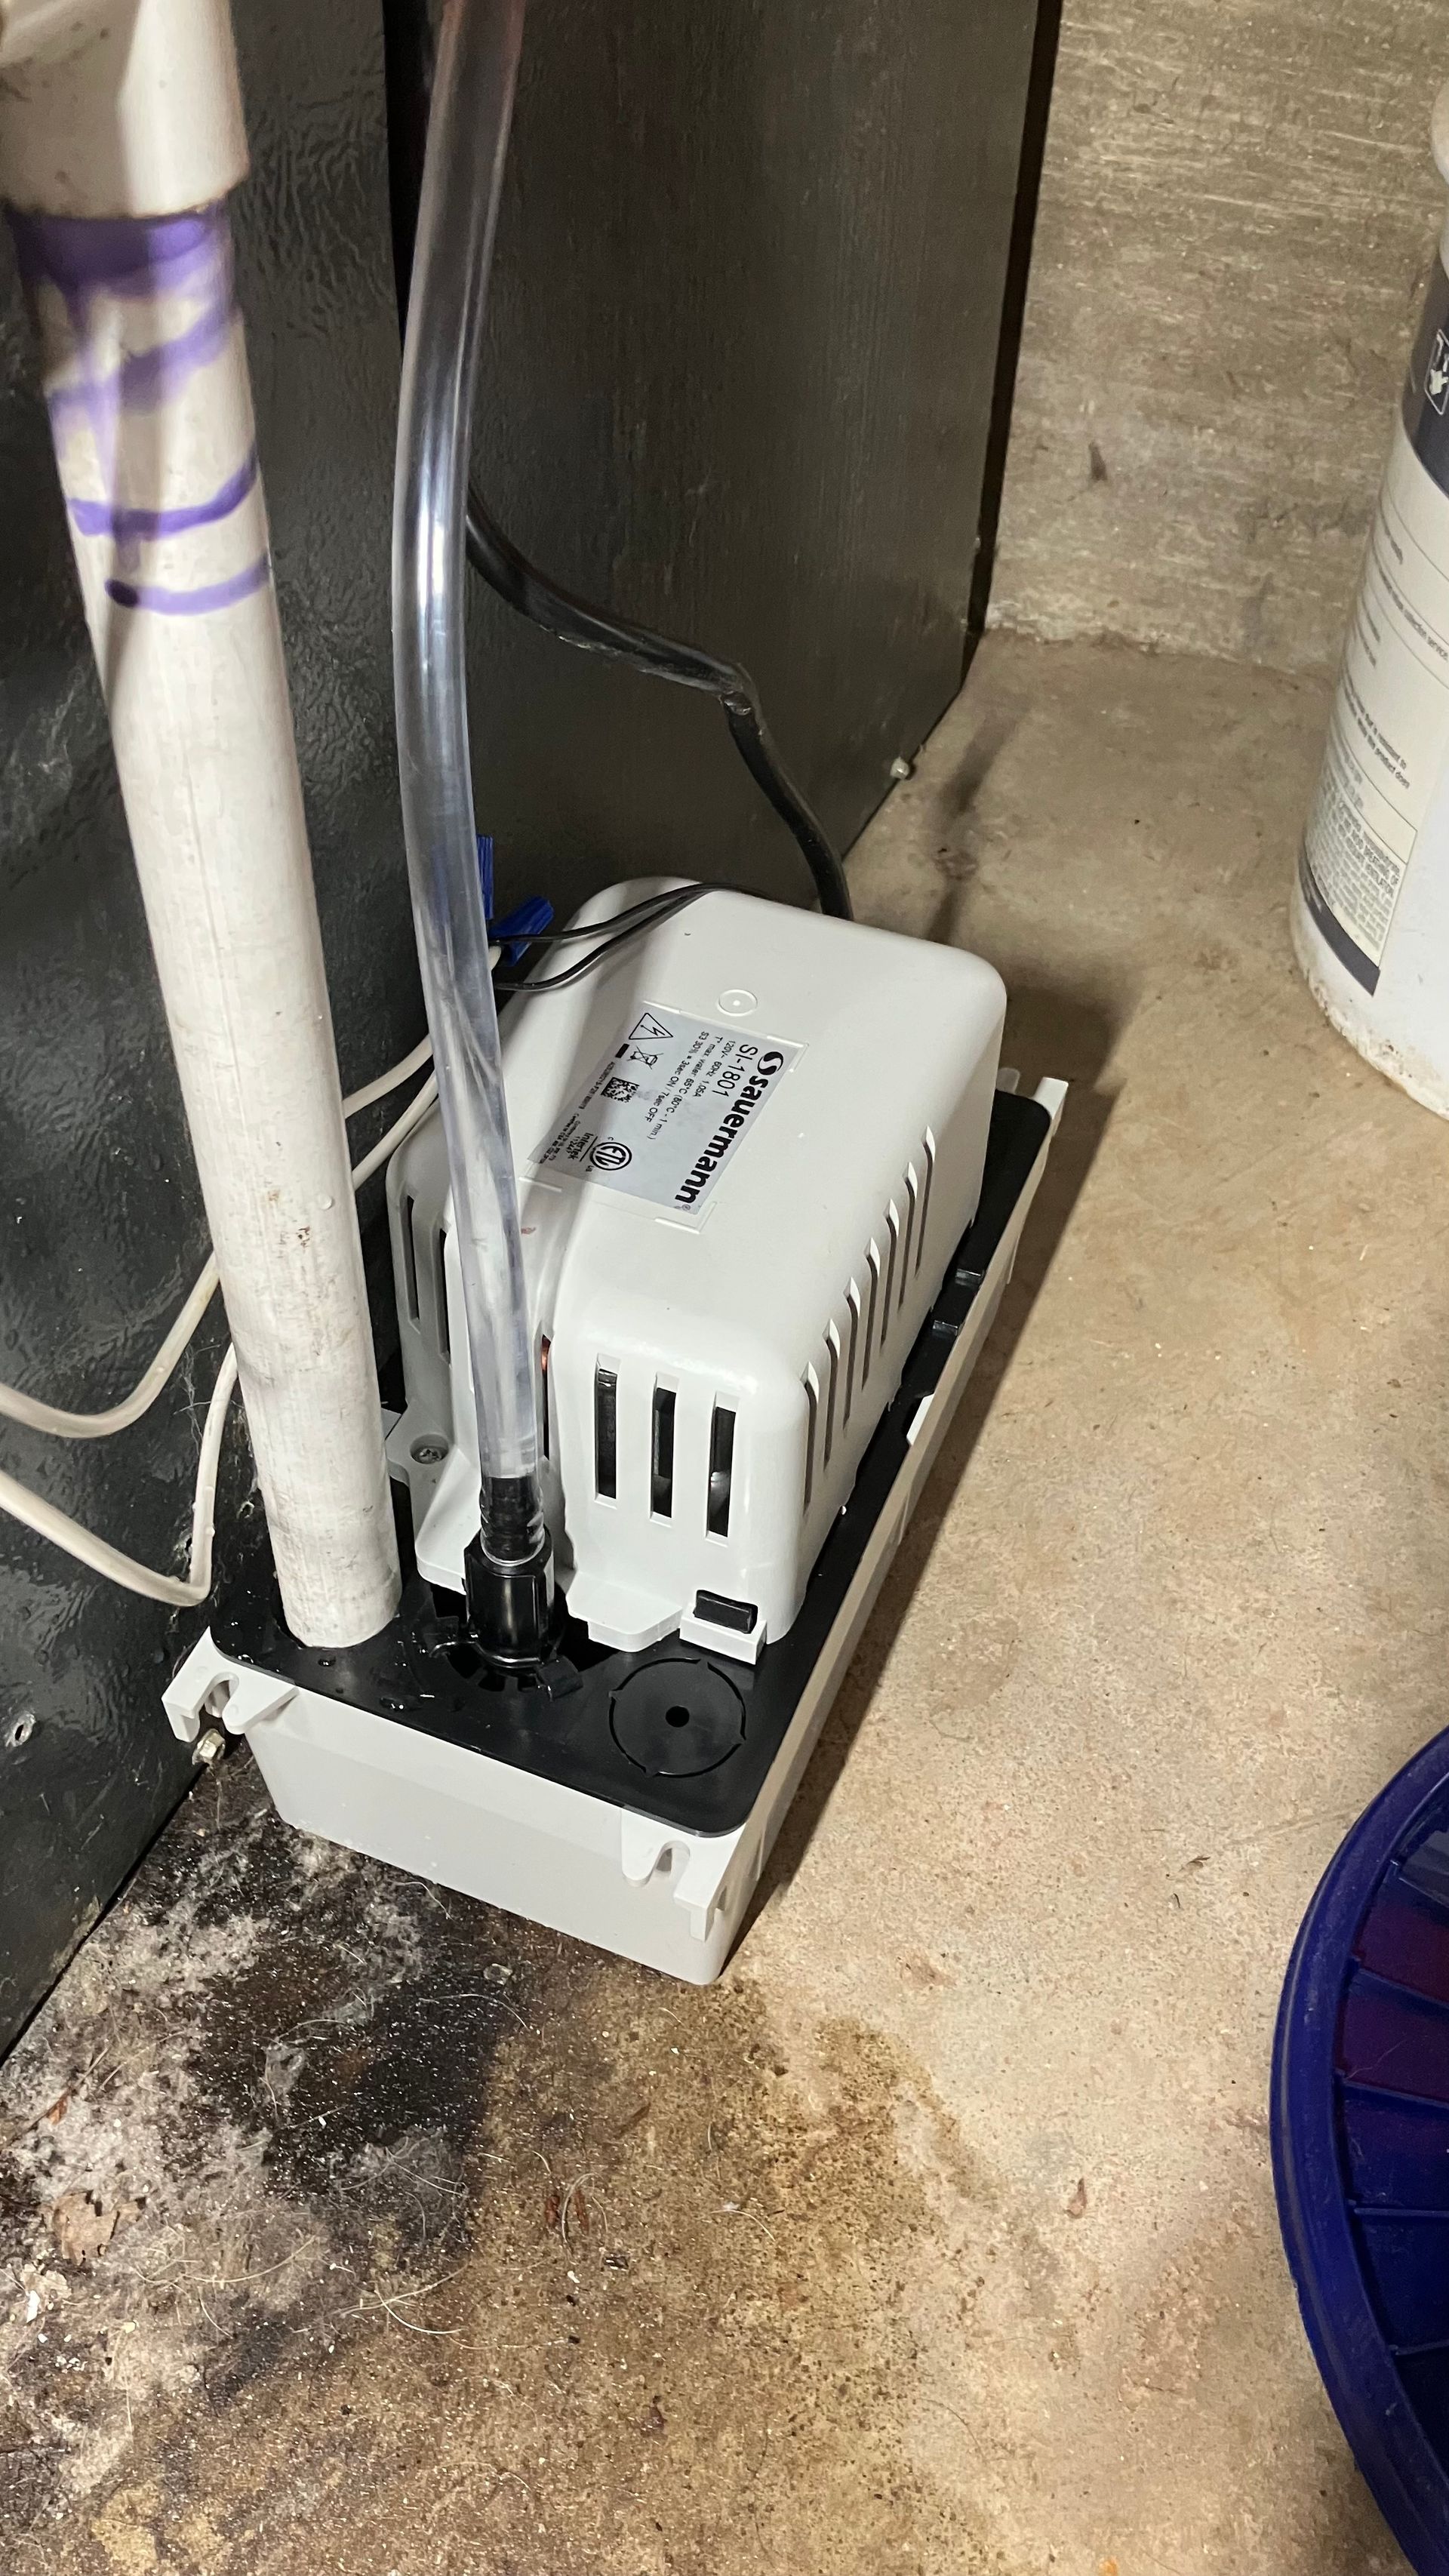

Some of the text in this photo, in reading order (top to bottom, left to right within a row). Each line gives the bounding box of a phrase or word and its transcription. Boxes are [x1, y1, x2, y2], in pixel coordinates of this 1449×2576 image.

[706, 1061, 722, 1076] 60Hz
[712, 1045, 758, 1097] SI-1801
[666, 1076, 678, 1087] ON
[645, 1107, 657, 1122] OFF
[675, 1076, 768, 1203] sauermann
